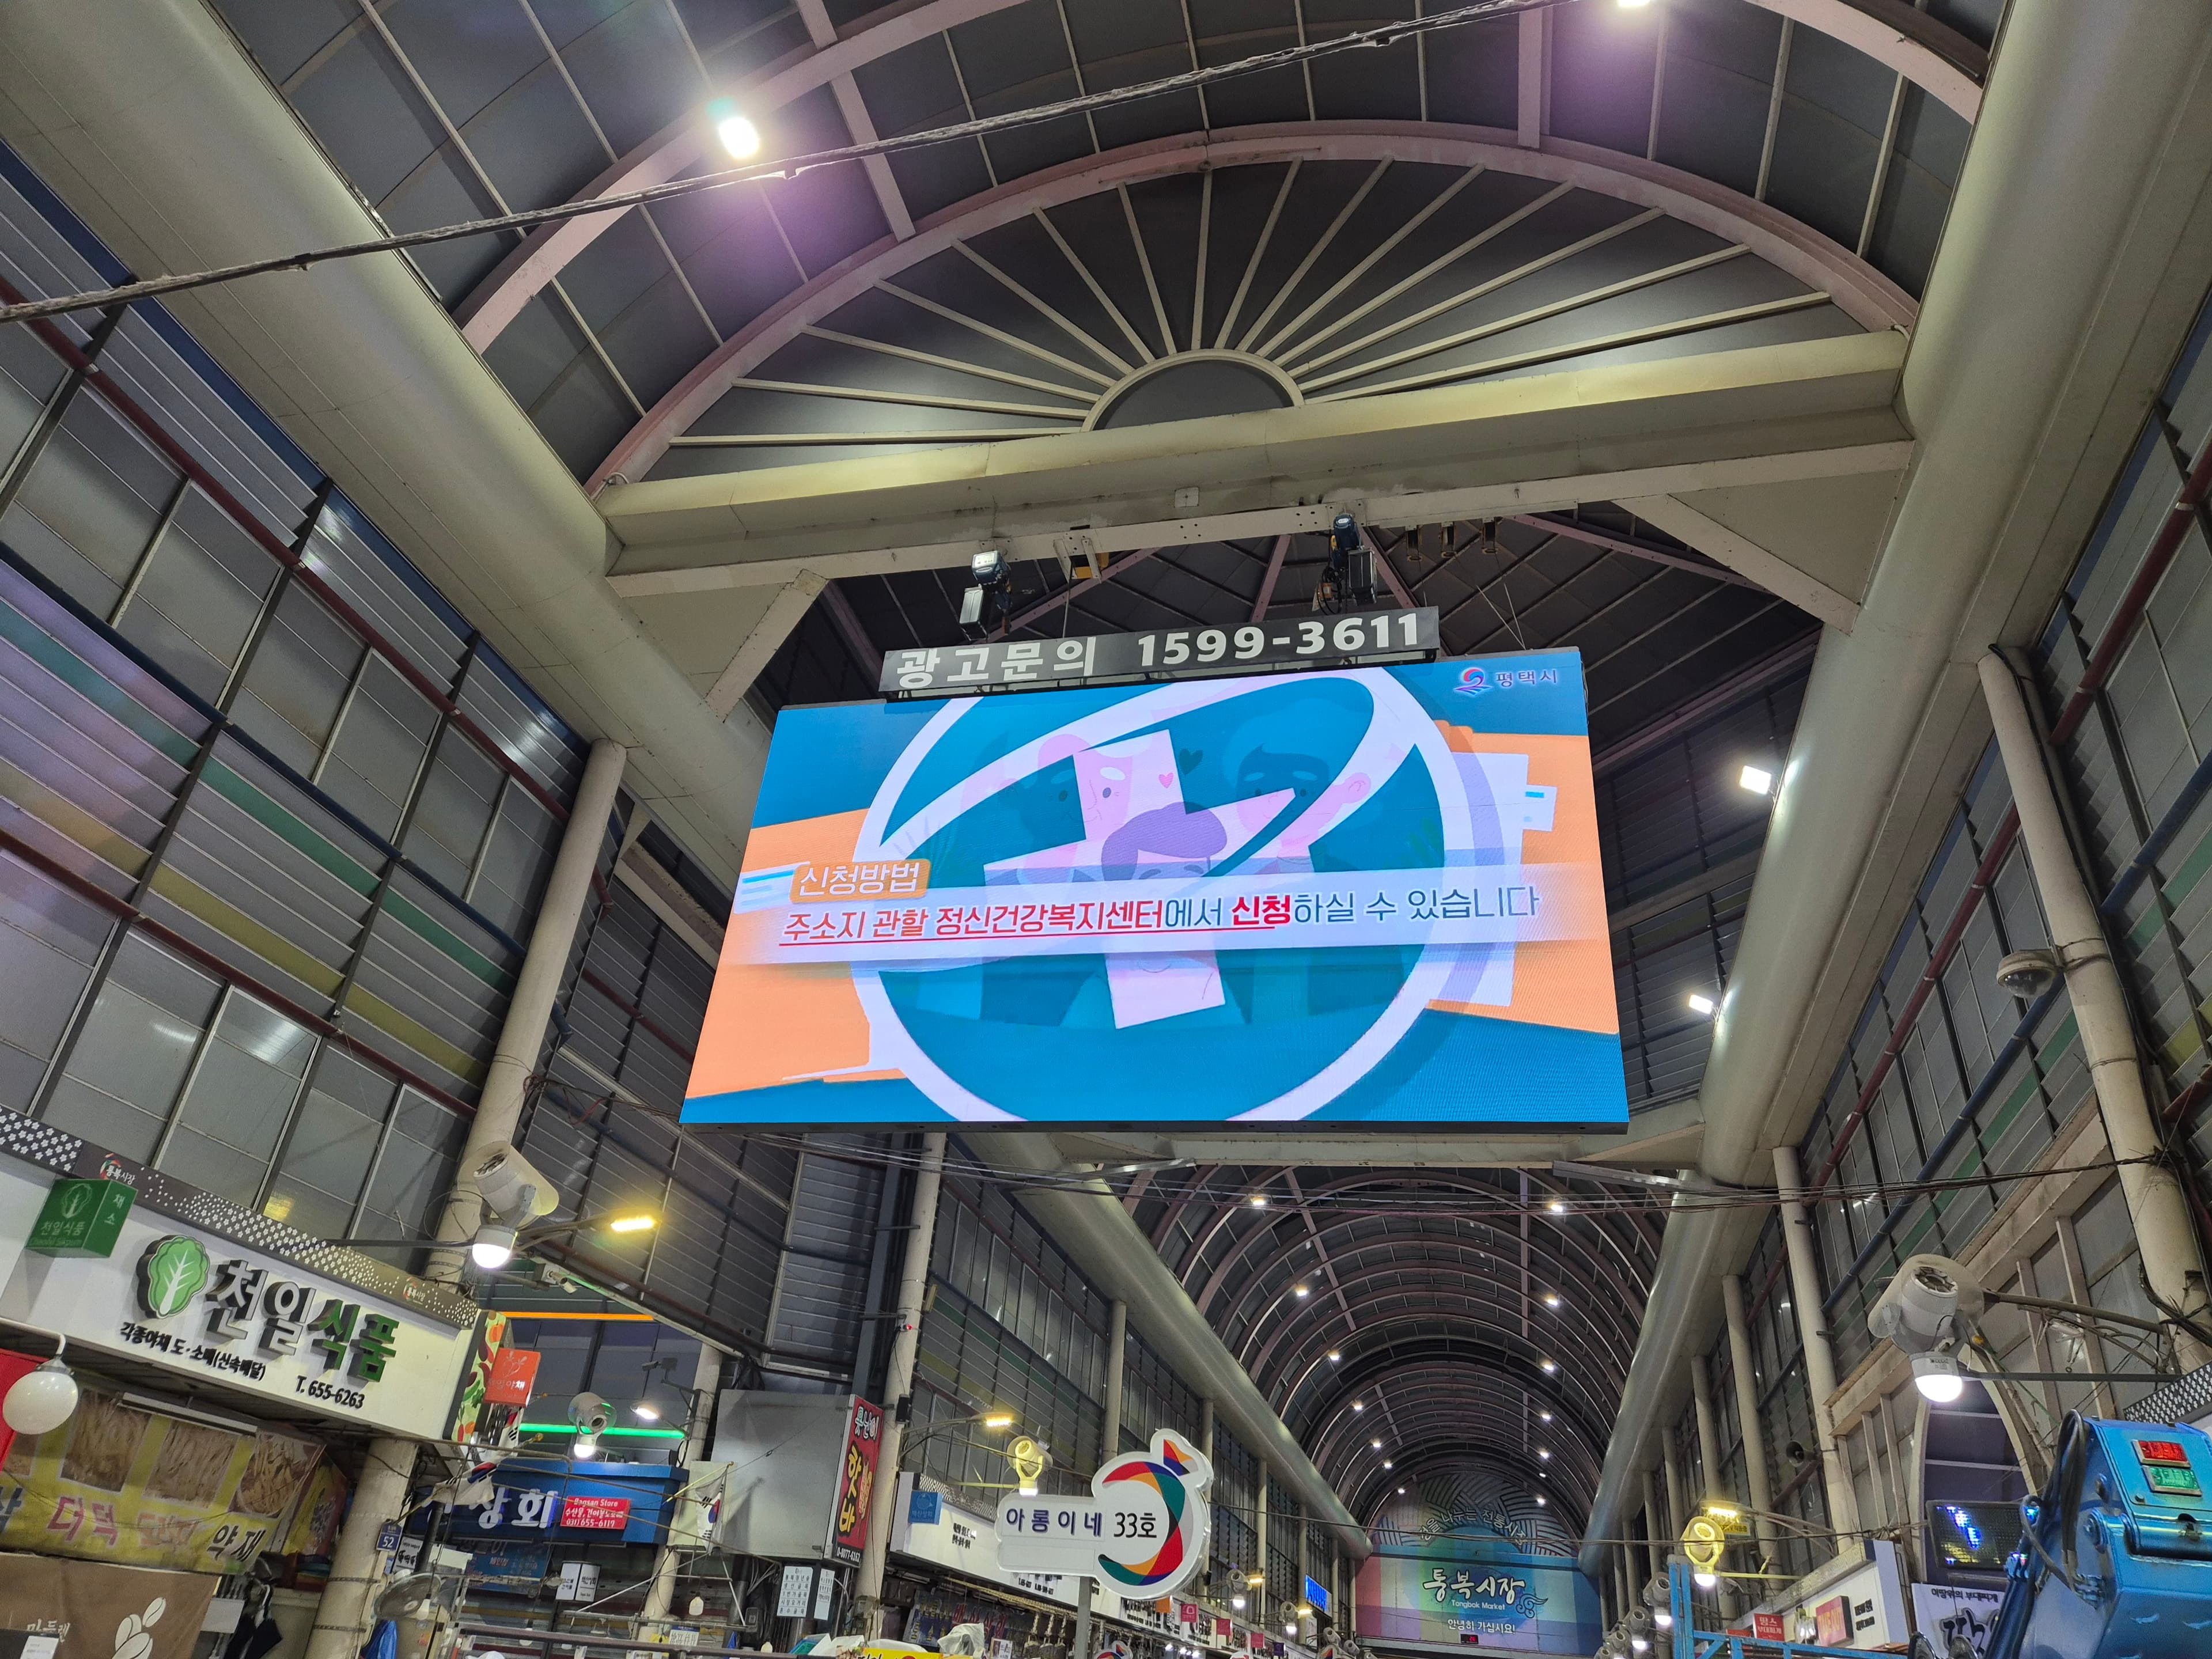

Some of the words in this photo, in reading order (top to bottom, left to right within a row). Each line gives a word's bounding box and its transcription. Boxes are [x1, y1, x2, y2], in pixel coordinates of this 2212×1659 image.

[897, 637, 1096, 688] 광고문의
[1137, 612, 1419, 666] 1599-3611
[1495, 669, 1557, 688] 평택시
[800, 861, 919, 896] 신청방법
[783, 911, 866, 940] 주소지
[873, 908, 927, 938] 관할
[935, 897, 1222, 937] 정신건강복지센터에서
[1232, 893, 1354, 926] 신청하실
[1366, 891, 1397, 922] 수
[1408, 885, 1540, 920] 있습니다
[41, 1221, 86, 1236] 천일식품
[206, 1259, 400, 1382] 천일식품
[120, 1321, 172, 1353] 각종야채
[297, 1375, 305, 1393] T.
[308, 1380, 366, 1409] 655-6263
[600, 1499, 618, 1507] Store
[1113, 1512, 1157, 1538] 33호
[207, 1525, 267, 1562] 약재
[382, 1536, 395, 1548] 52
[1423, 1568, 1526, 1604] 통복시장
[1451, 1599, 1480, 1609] Tongbok
[1482, 1602, 1505, 1610] Market
[1448, 1619, 1474, 1631] 안녕히
